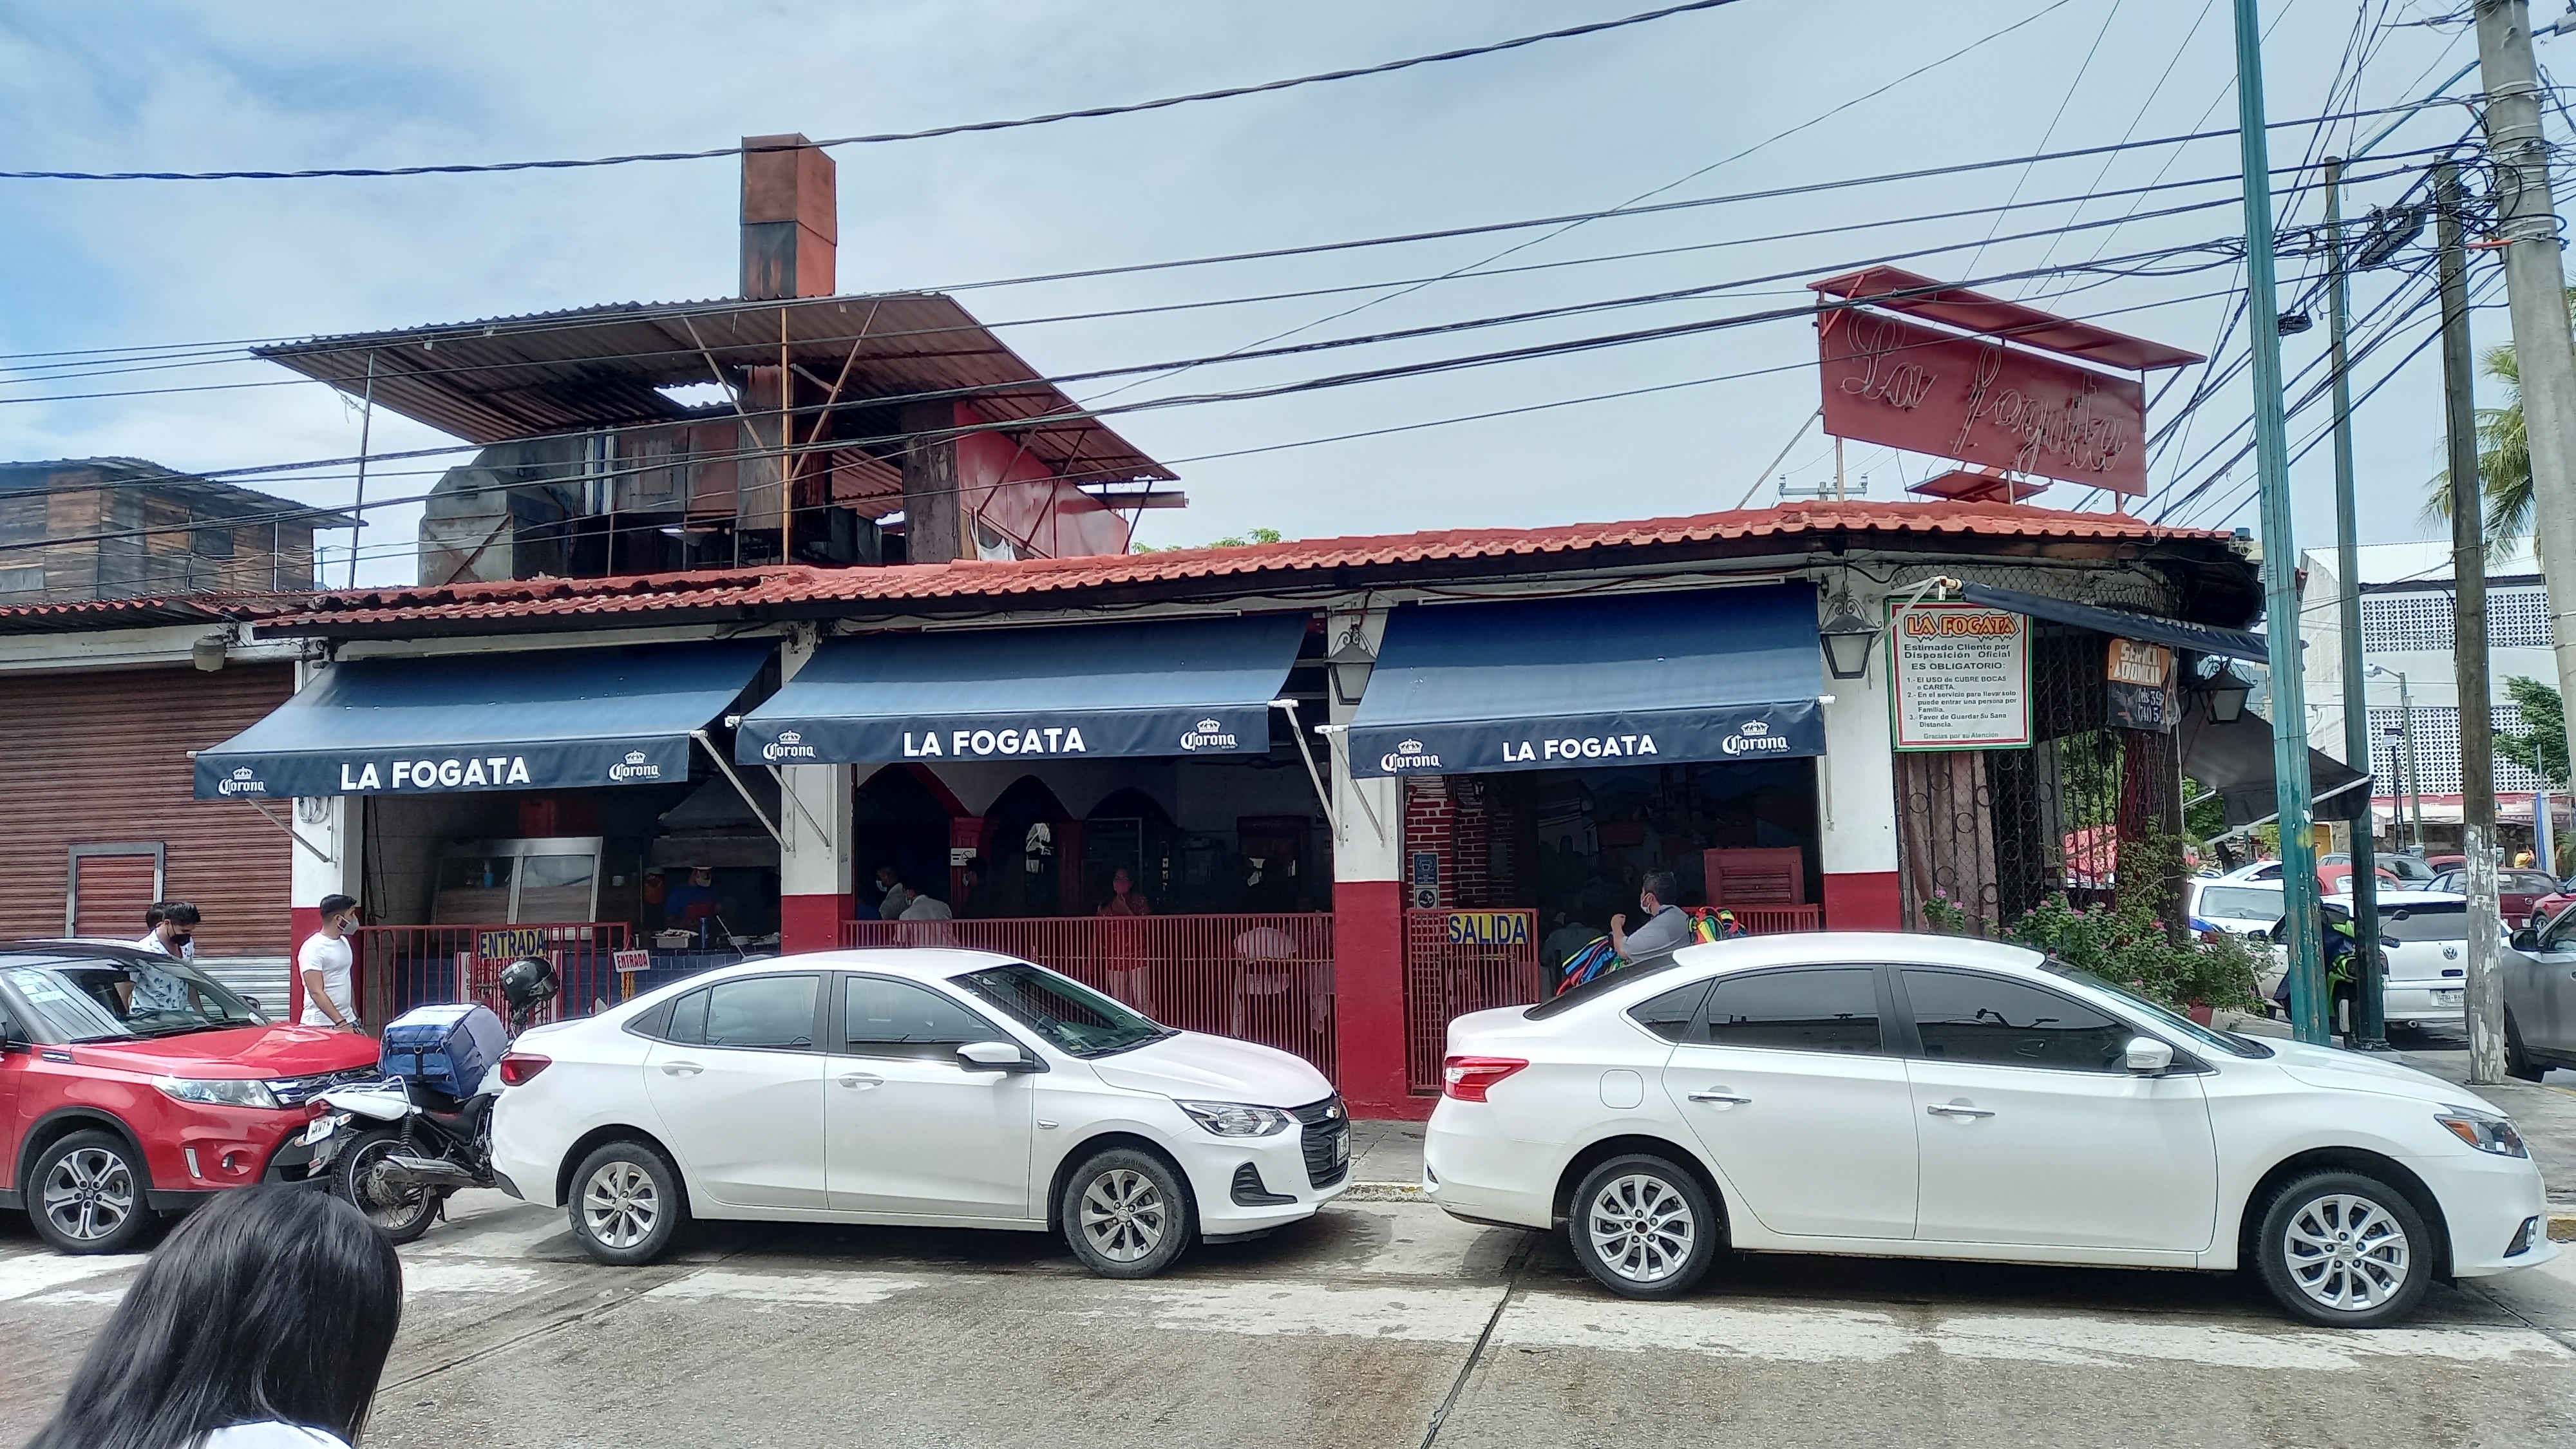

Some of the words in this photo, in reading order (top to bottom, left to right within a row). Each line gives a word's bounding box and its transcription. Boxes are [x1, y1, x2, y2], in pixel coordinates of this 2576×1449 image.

[1906, 616, 1937, 636] LA
[1940, 616, 2018, 636] FOGATA
[1904, 651, 1971, 660] Disposición
[1978, 650, 2011, 659] Oficial
[1994, 644, 2011, 652] por
[1929, 662, 2006, 670] OBLIGATORIO:
[761, 741, 817, 761] Corona
[903, 730, 943, 758] LA
[952, 727, 1087, 757] FOGATA
[1179, 731, 1238, 752] Corona
[1502, 741, 1537, 762] LA
[1544, 734, 1659, 761] FOGATA
[1721, 733, 1791, 756] Corona
[339, 761, 382, 791] LA
[391, 755, 532, 790] FOGATA
[609, 761, 661, 782] Corona
[1380, 752, 1443, 774] Corona
[217, 777, 267, 797] Corona
[1448, 915, 1528, 944] SALIDA
[480, 929, 547, 959] ENTRADA
[616, 954, 649, 970] ENTRADA
